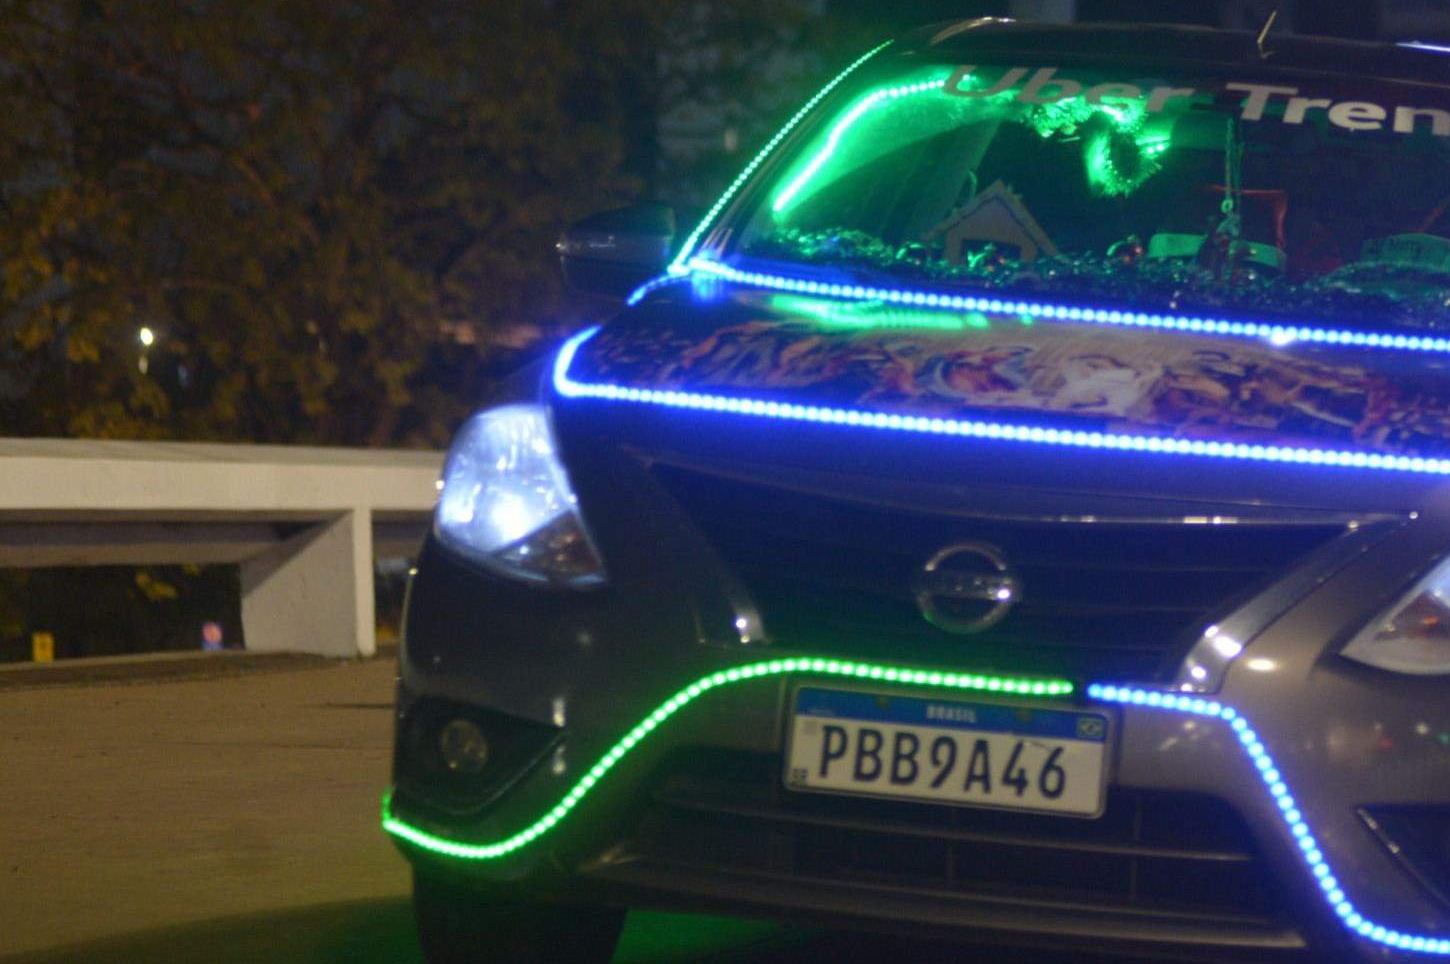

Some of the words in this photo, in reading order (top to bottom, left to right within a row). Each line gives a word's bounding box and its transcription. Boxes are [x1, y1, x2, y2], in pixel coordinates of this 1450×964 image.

[944, 65, 1196, 113] Uber
[926, 704, 977, 723] BRASIL
[820, 725, 1066, 798] PBB9A46
